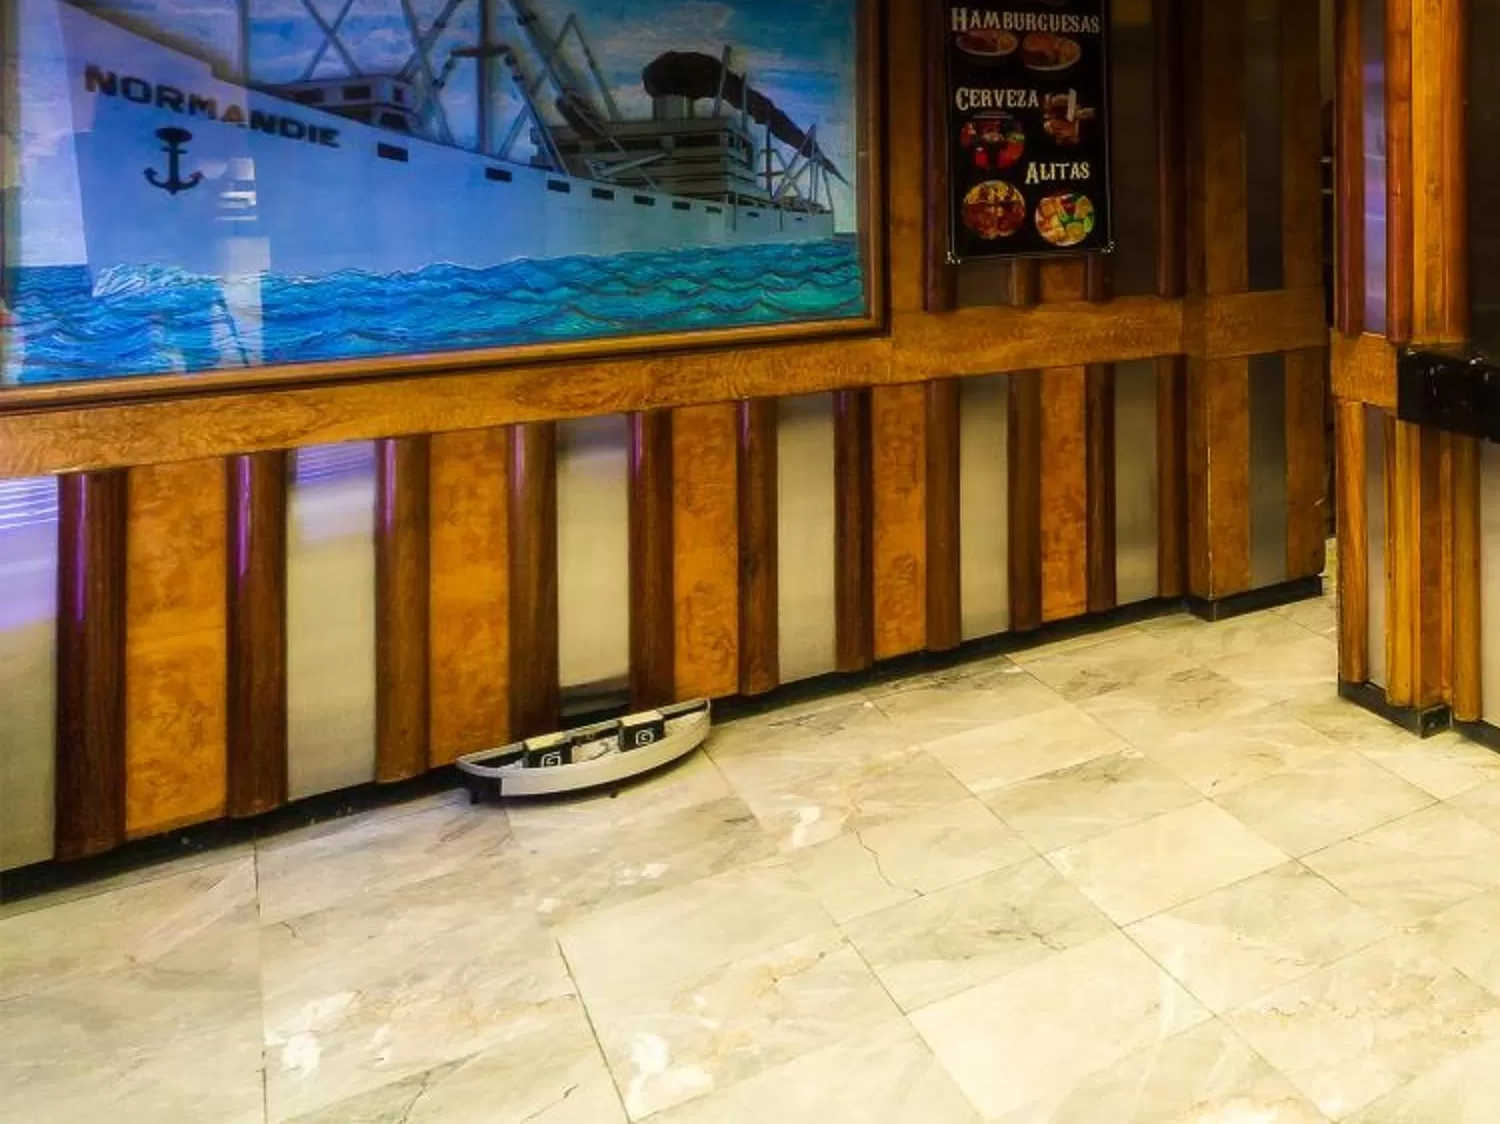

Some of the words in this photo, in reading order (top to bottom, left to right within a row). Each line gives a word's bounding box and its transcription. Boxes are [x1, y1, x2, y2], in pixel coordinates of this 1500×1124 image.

[950, 7, 1101, 34] HAMBURGUESAS
[84, 63, 341, 148] NORMANDIE
[955, 87, 1039, 111] CERVEZA
[1025, 162, 1091, 185] ALITAS
